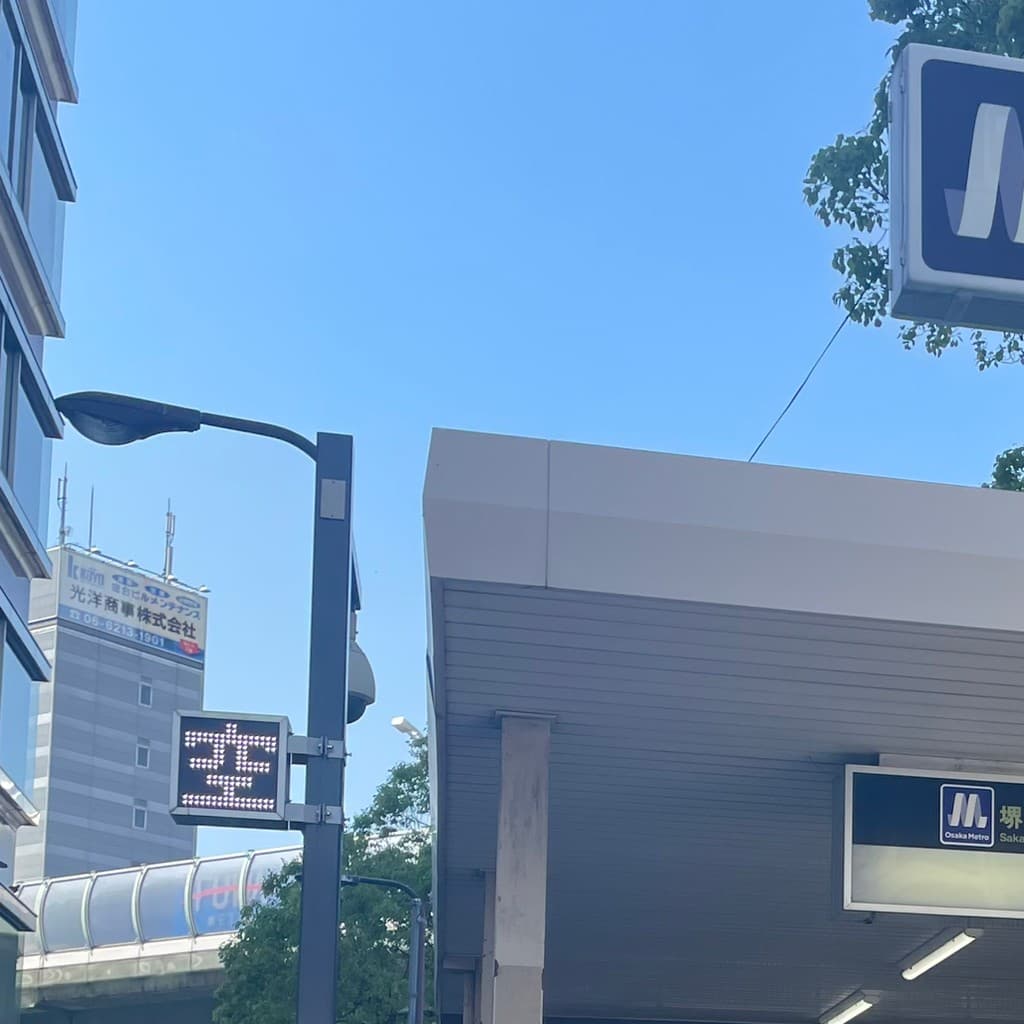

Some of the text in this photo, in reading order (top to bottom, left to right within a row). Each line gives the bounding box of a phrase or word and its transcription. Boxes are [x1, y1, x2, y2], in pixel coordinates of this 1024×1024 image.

[182, 722, 277, 810] 空
[944, 831, 990, 841] Osaka Metro
